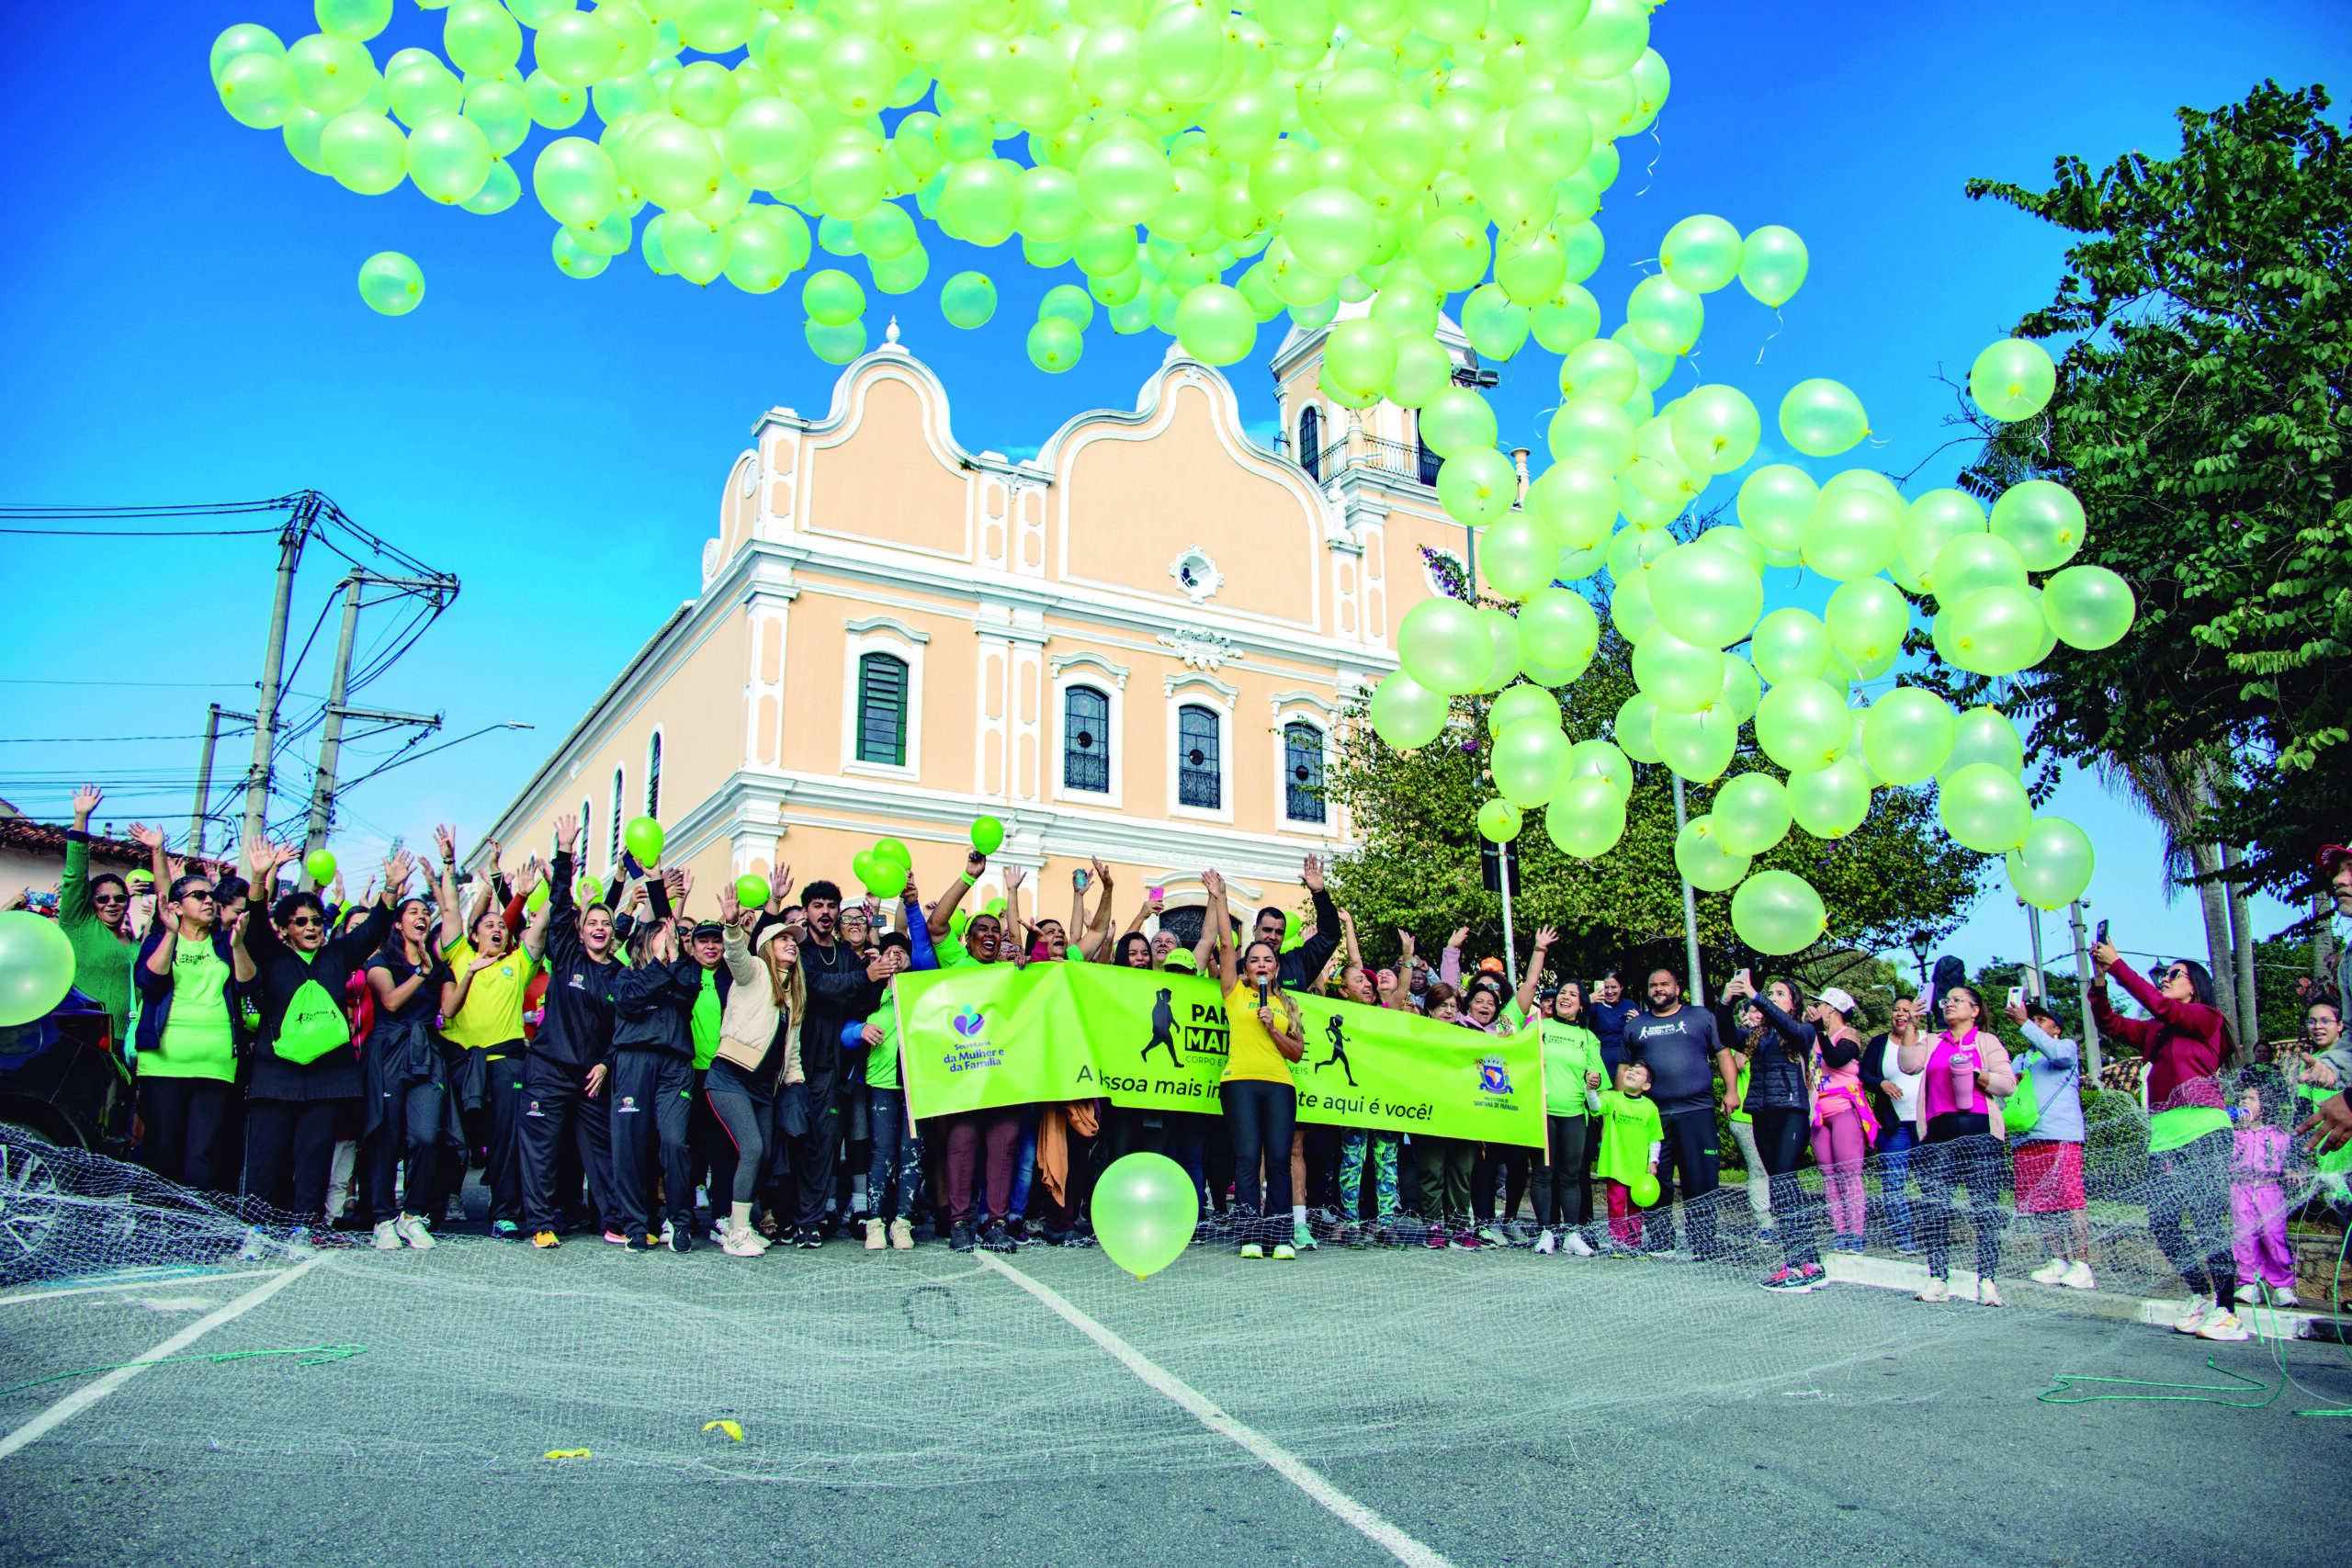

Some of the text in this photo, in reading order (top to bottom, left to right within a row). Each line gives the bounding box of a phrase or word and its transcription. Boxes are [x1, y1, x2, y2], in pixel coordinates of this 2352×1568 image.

[955, 1040, 990, 1050] Secretaria
[1187, 1028, 1229, 1053] MAI
[944, 1048, 1004, 1064] da Mulher e
[1185, 1055, 1216, 1066] CORPO
[949, 1063, 963, 1073] da
[1077, 1065, 1093, 1083] A
[1099, 1068, 1148, 1092] ssoa
[1155, 1078, 1202, 1097] mais
[1323, 1096, 1364, 1114] aqui
[1369, 1098, 1380, 1114] é
[1385, 1103, 1433, 1121] você!
